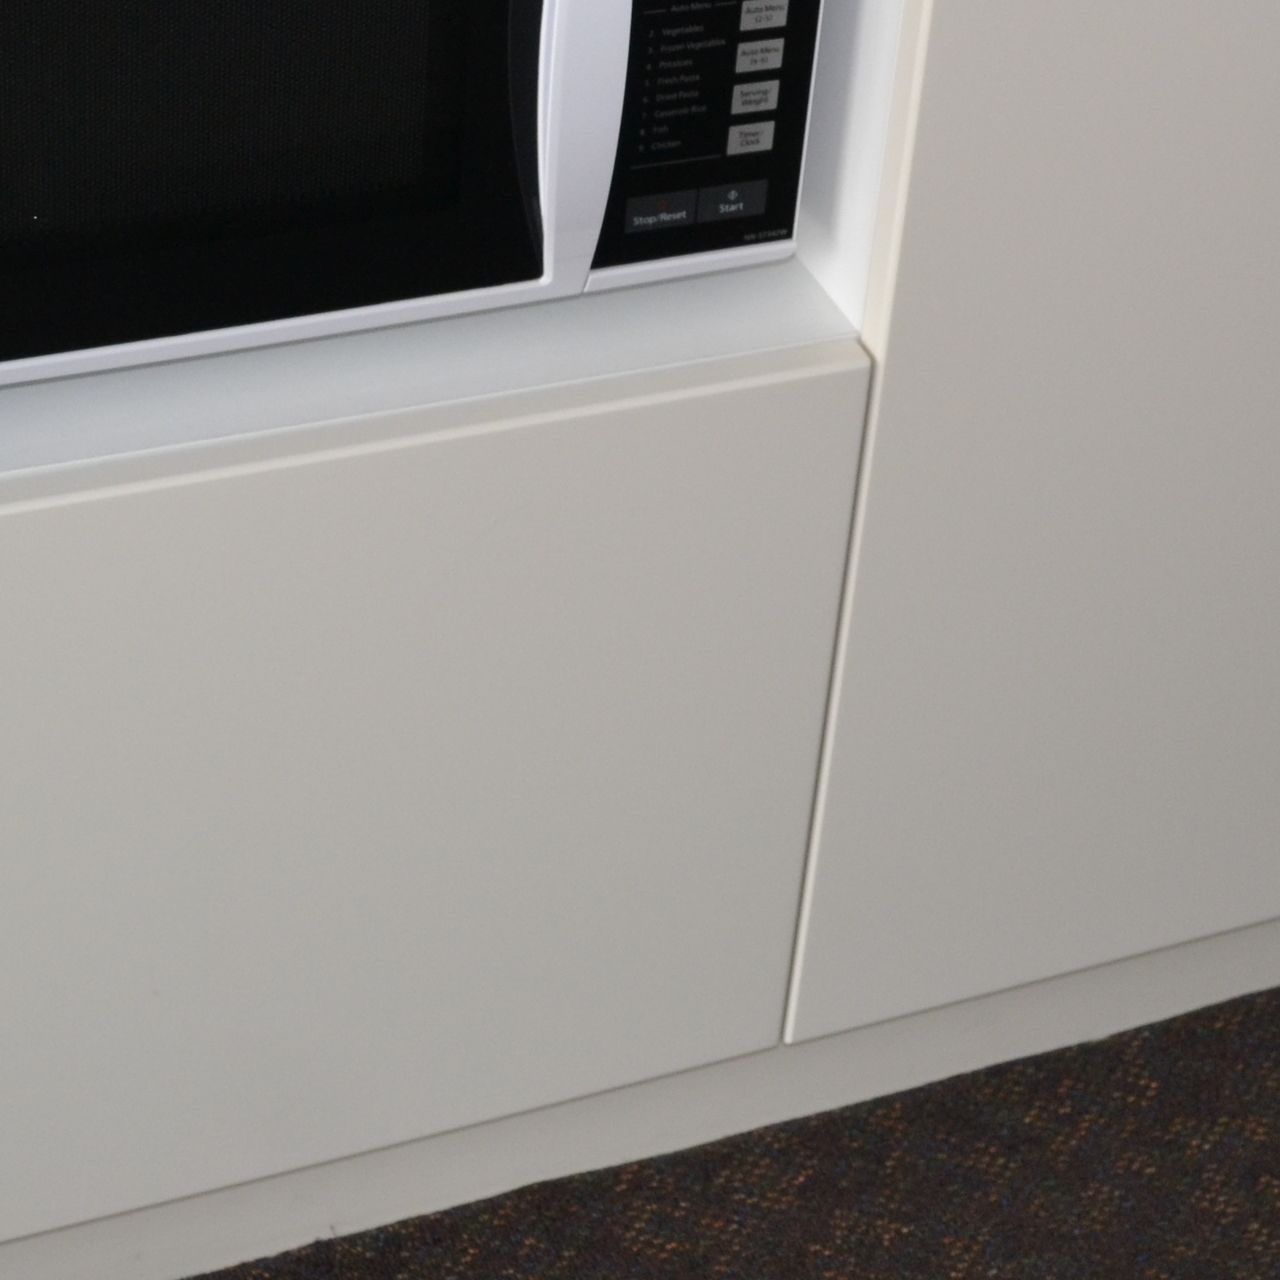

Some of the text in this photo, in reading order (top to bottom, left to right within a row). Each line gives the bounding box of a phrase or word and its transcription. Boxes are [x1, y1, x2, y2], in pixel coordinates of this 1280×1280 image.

[744, 6, 763, 14] Auto
[662, 24, 704, 37] Vegetables
[740, 48, 759, 56] Auto
[740, 138, 760, 147] Clock
[719, 201, 744, 214] Start
